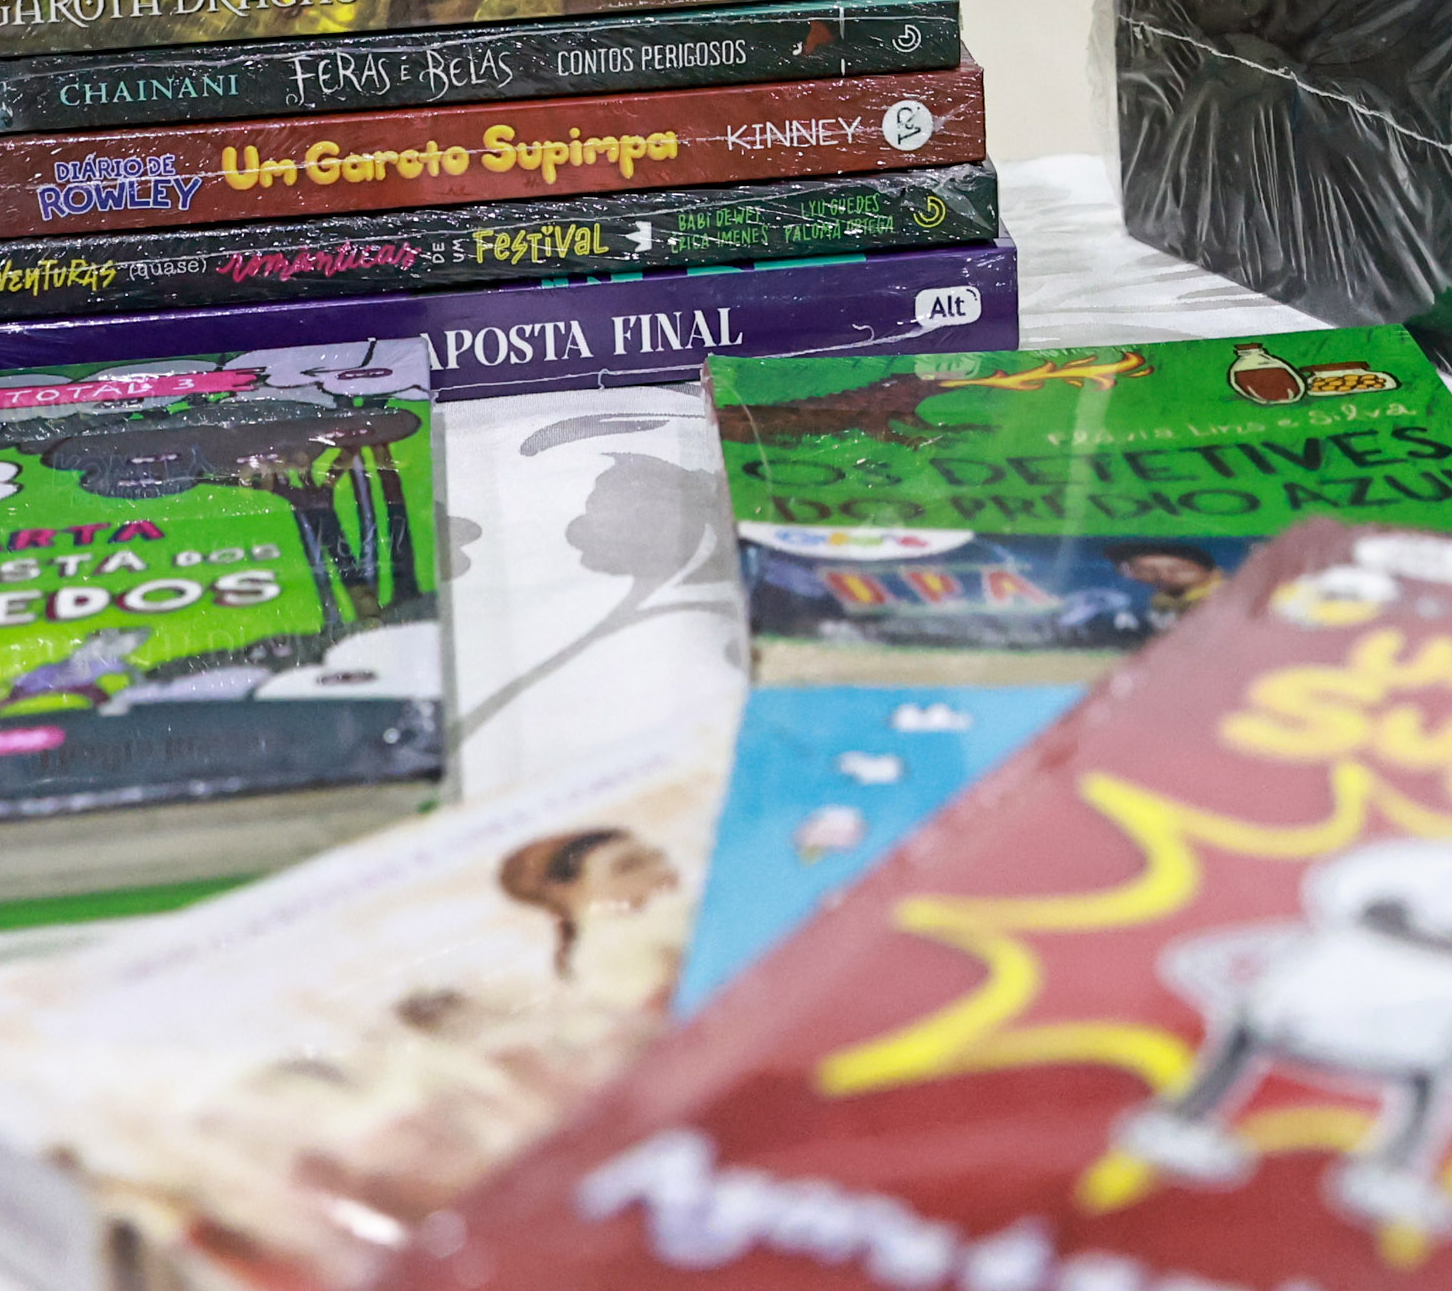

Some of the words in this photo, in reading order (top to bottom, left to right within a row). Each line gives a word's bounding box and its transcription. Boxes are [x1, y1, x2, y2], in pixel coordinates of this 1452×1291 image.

[60, 73, 240, 106] CHAINANI
[286, 53, 390, 105] FERAS
[401, 64, 408, 81] E
[418, 49, 513, 101] BELAS
[557, 46, 634, 76] CONTOS
[641, 40, 746, 71] PERIGOSOS
[55, 153, 143, 181] DIÁRIO
[149, 156, 174, 175] DE
[221, 145, 299, 190] Um
[305, 135, 469, 185] Garoto
[482, 124, 678, 184] Supimpa
[726, 117, 861, 150] KINNEY
[39, 177, 202, 220] ROWLEY
[128, 256, 208, 281] (quase)
[611, 307, 743, 354] FINAL
[929, 295, 966, 318] Alt
[8, 381, 154, 409] TOTAL
[169, 378, 195, 396] 3
